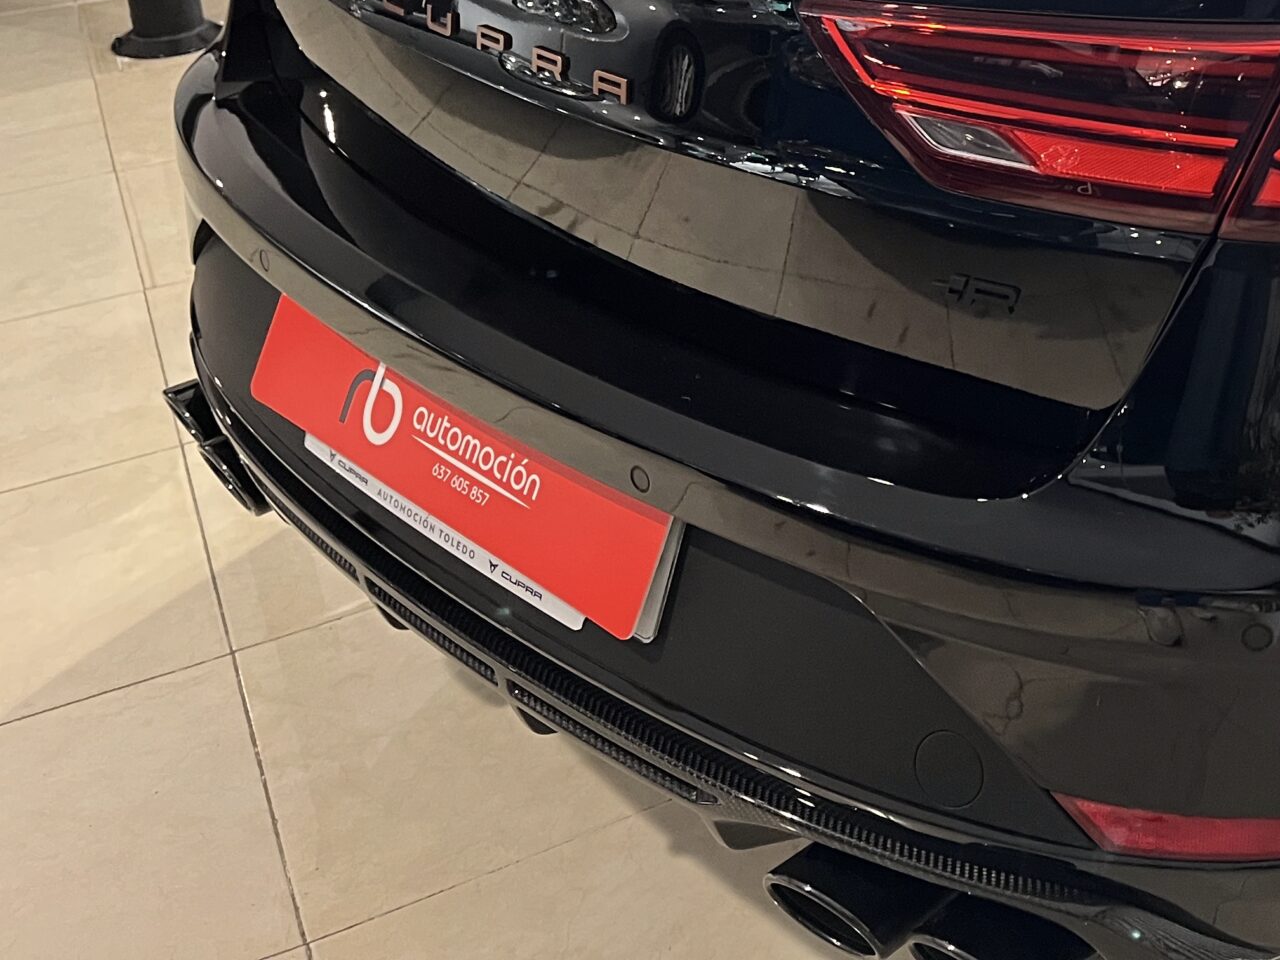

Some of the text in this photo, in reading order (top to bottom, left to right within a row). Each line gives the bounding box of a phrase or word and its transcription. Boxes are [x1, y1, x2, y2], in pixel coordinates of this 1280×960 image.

[412, 405, 541, 501] automoción
[432, 462, 490, 506] 637 605 857
[337, 459, 543, 601] CUPRA AUTOMOCIÓN TOLEDO CUPRA
